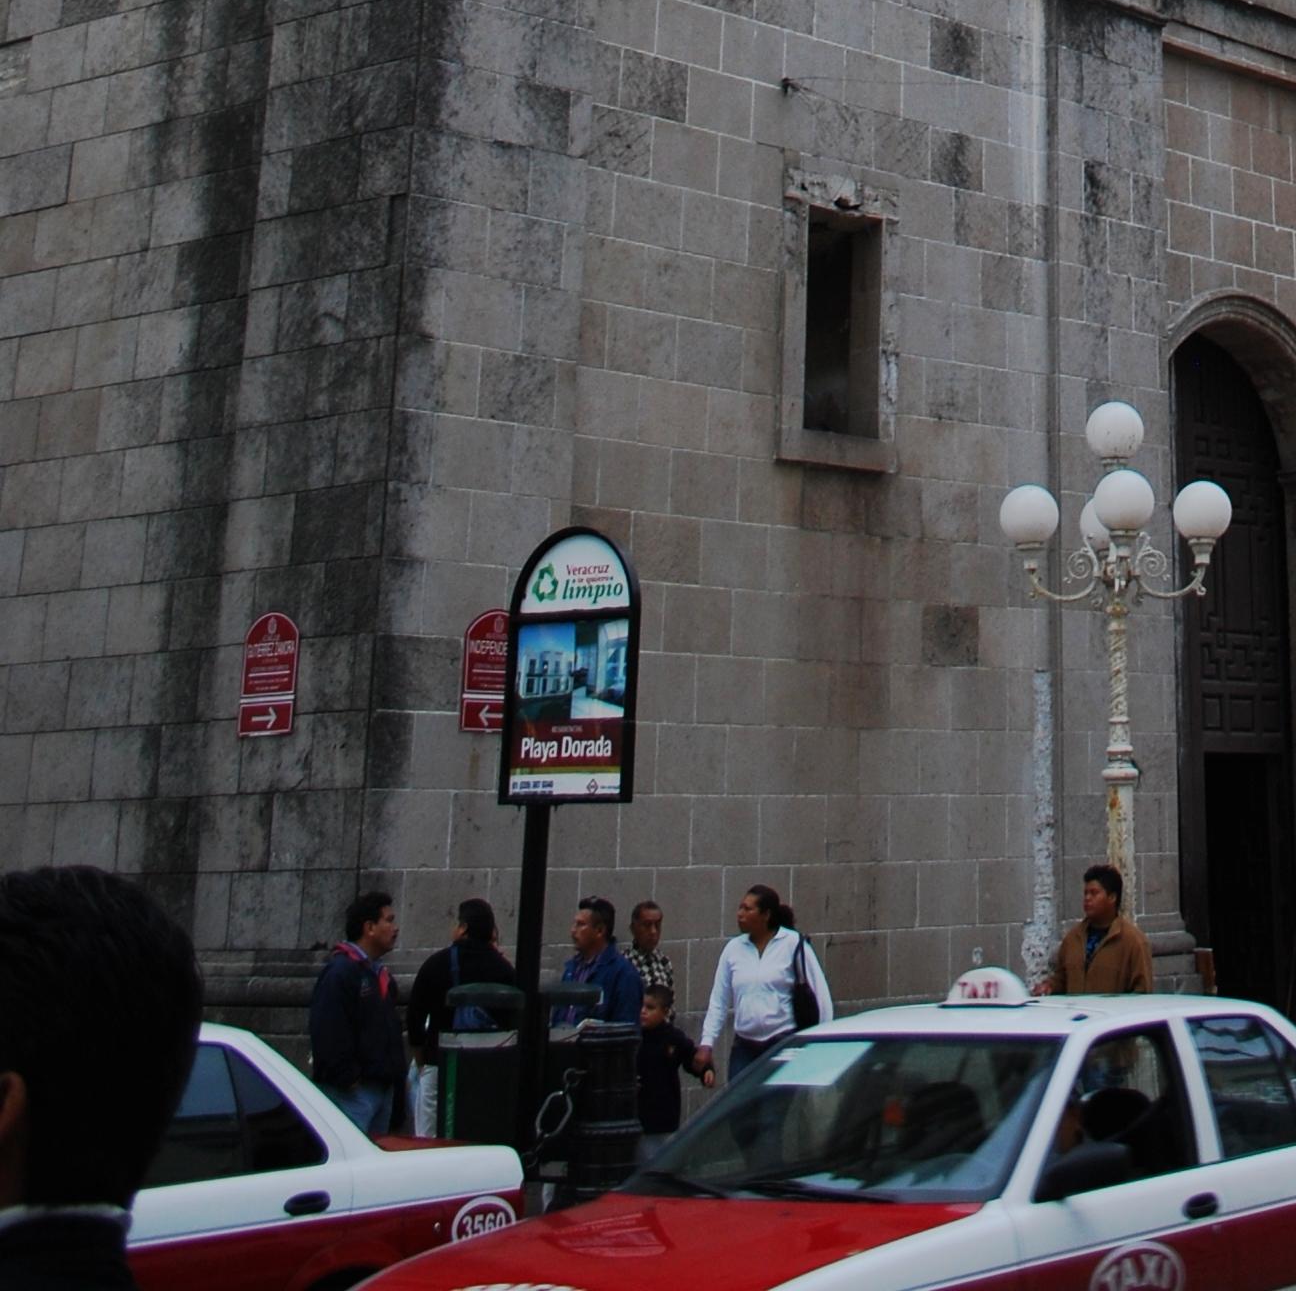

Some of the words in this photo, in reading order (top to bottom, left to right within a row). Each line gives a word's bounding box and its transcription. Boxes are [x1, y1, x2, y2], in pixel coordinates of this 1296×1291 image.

[566, 564, 610, 576] Veracruz
[562, 578, 623, 604] limpio
[521, 737, 558, 763] Playa
[561, 734, 612, 757] Dorada
